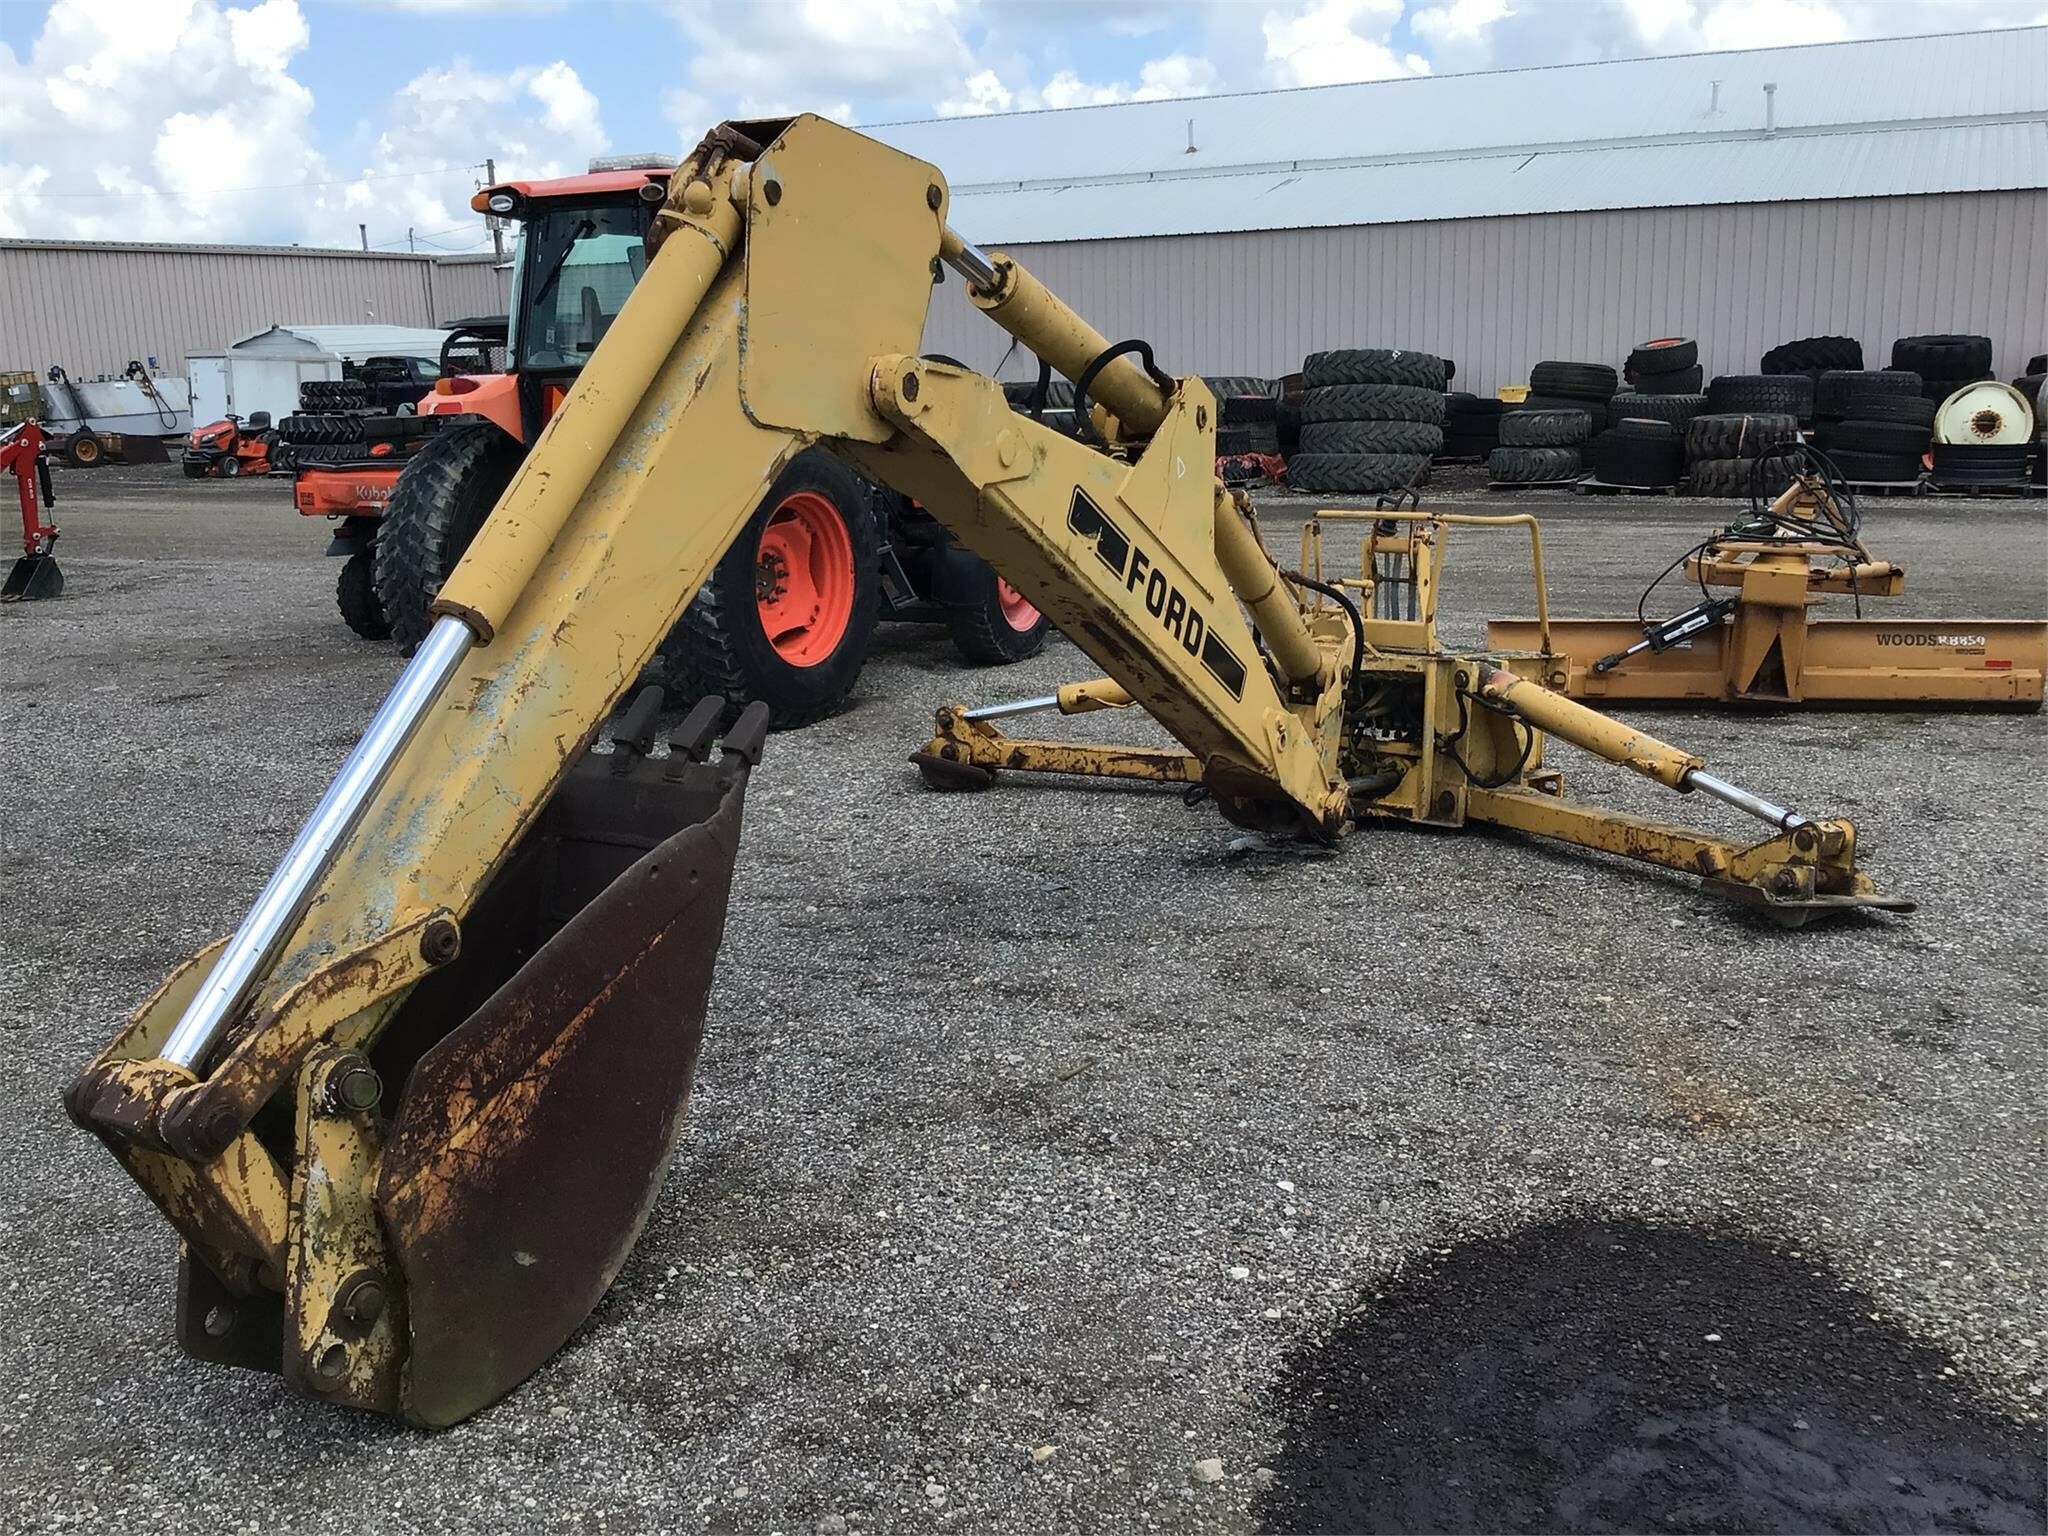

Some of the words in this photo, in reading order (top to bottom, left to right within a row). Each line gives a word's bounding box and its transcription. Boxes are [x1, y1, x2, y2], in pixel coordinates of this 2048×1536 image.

[356, 485, 393, 501] Kubot
[1126, 546, 1204, 657] FORD
[1876, 633, 1937, 646] WOODS
